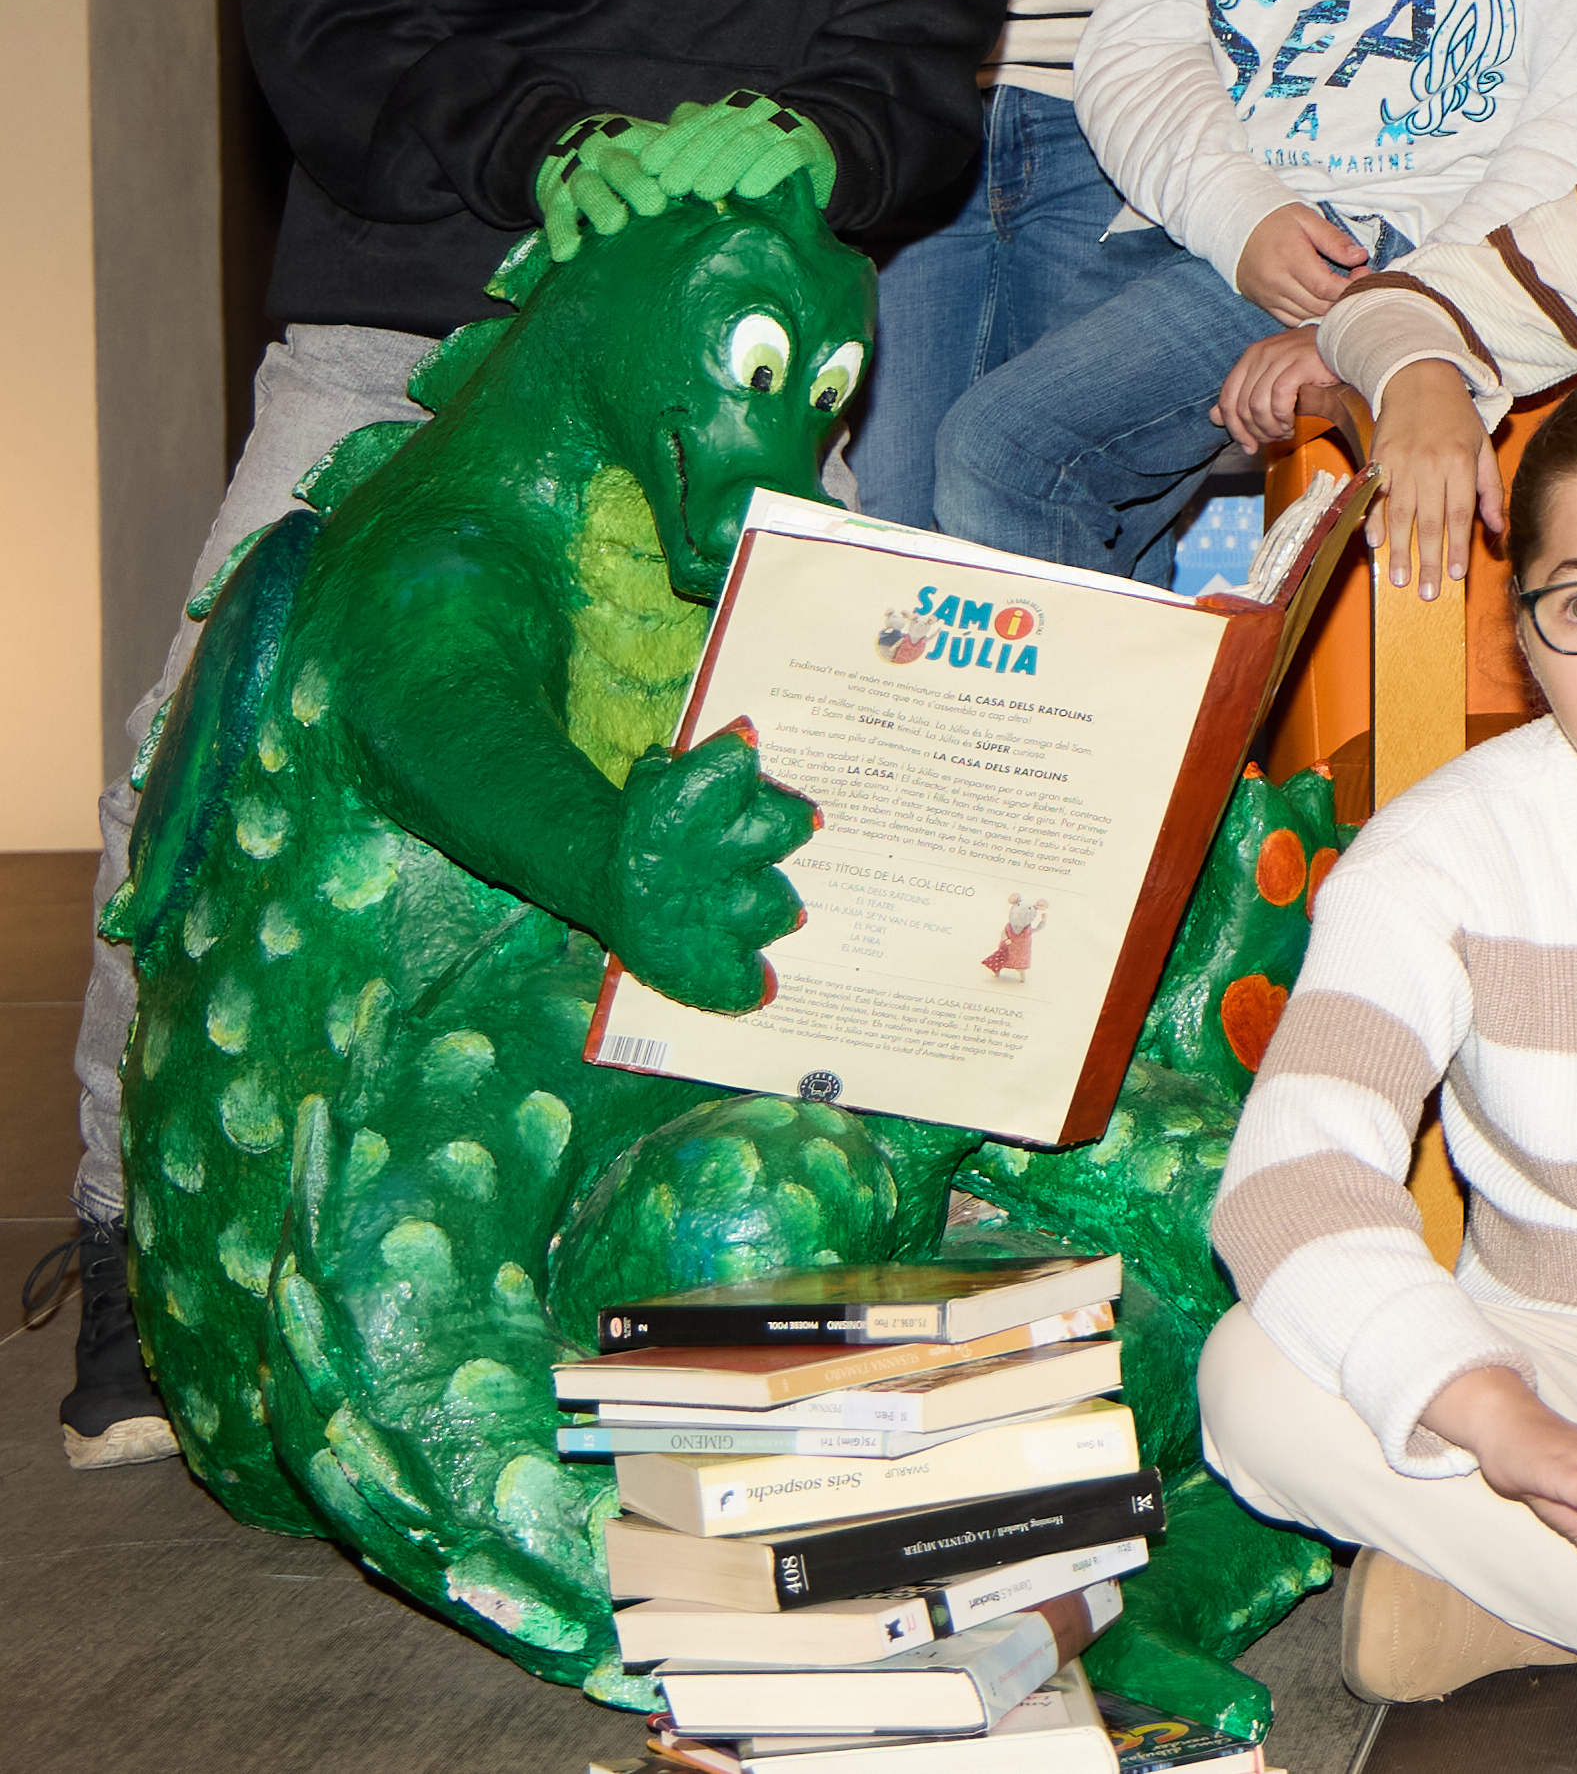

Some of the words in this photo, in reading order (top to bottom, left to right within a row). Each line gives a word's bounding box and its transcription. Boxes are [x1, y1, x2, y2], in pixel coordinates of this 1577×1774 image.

[1265, 150, 1415, 174] SOUS-MARINE
[914, 585, 994, 631] SAM
[925, 630, 1038, 675] JÚLIA
[788, 658, 833, 674] Endinsa't
[896, 681, 942, 697] miniatura
[943, 690, 956, 699] de
[957, 692, 972, 702] LA
[974, 694, 1006, 708] CASA
[1008, 700, 1035, 712] DELS
[774, 721, 799, 734] Junts
[800, 726, 826, 737] viuen
[828, 731, 846, 740] una
[847, 733, 866, 745] pila
[932, 751, 947, 761] LA
[949, 755, 982, 768] CASA
[984, 761, 1011, 773] DELS
[792, 855, 832, 871] ALTRES
[833, 860, 872, 878] TÍTOLS
[873, 870, 889, 881] DE
[890, 873, 906, 884] LA
[768, 1320, 788, 1330] POOL
[789, 1320, 818, 1330] PHOEBE
[875, 1318, 888, 1328] Poo
[825, 1362, 872, 1382] TAMARO
[871, 1354, 919, 1373] SUSANNA
[875, 1411, 895, 1421] Pen
[900, 1412, 907, 1421] N
[671, 1435, 733, 1449] GIMENO
[885, 1463, 929, 1478] SWARUP
[828, 1472, 862, 1489] Seis
[1030, 1515, 1063, 1530] Henning
[938, 1531, 976, 1549] QUINTA
[977, 1530, 990, 1540] LA
[904, 1540, 935, 1555] MUJER
[782, 1555, 804, 1593] 408
